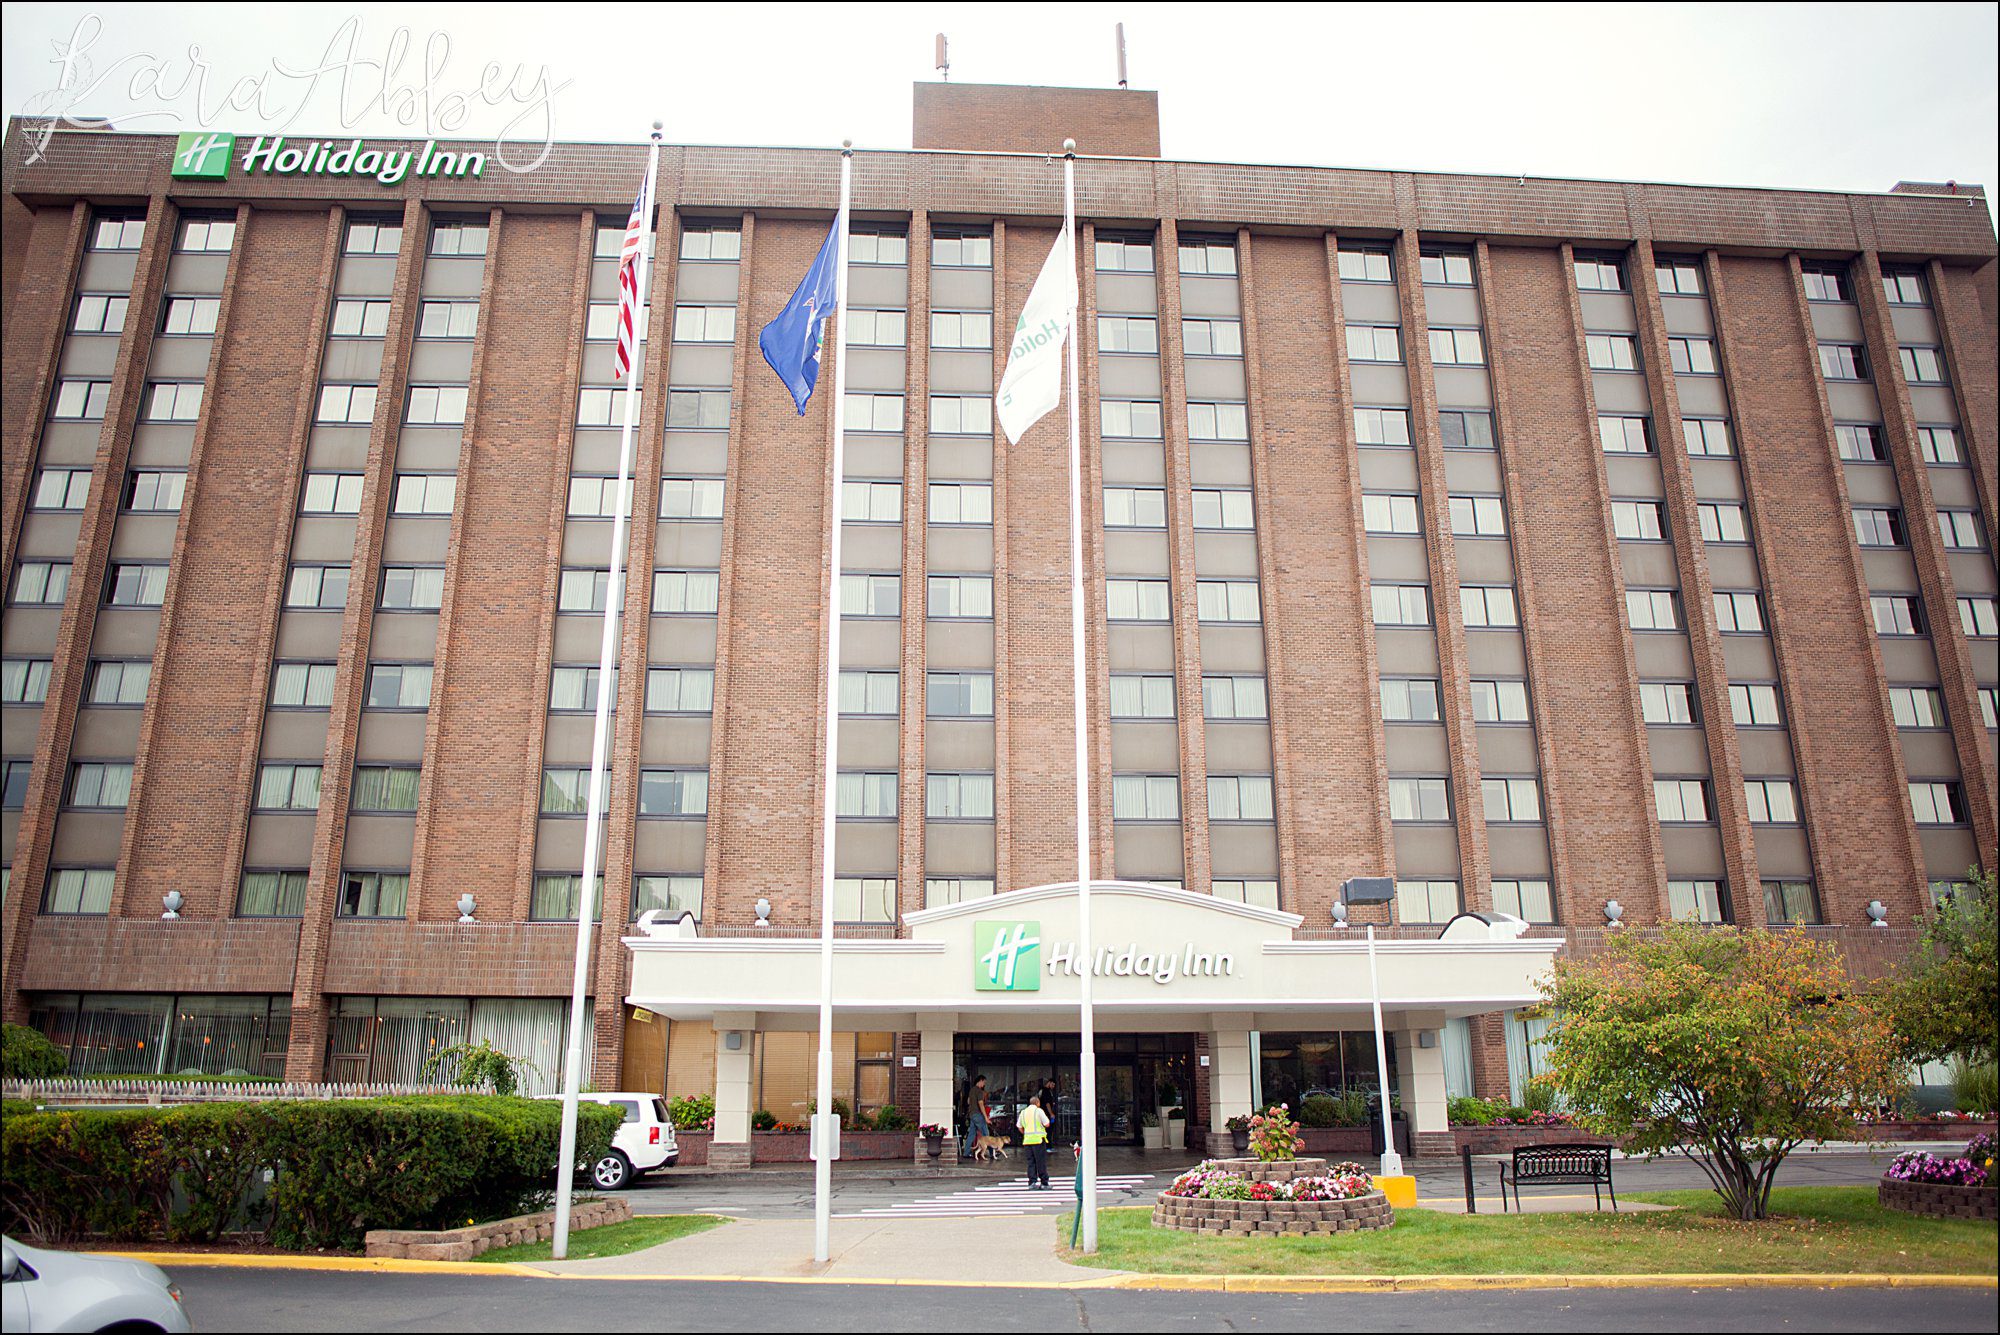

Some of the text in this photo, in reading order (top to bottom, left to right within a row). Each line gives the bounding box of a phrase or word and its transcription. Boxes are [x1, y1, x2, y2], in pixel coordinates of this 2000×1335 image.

[242, 136, 412, 186] Holiday
[416, 140, 486, 177] Inn
[1182, 942, 1234, 976] Inn
